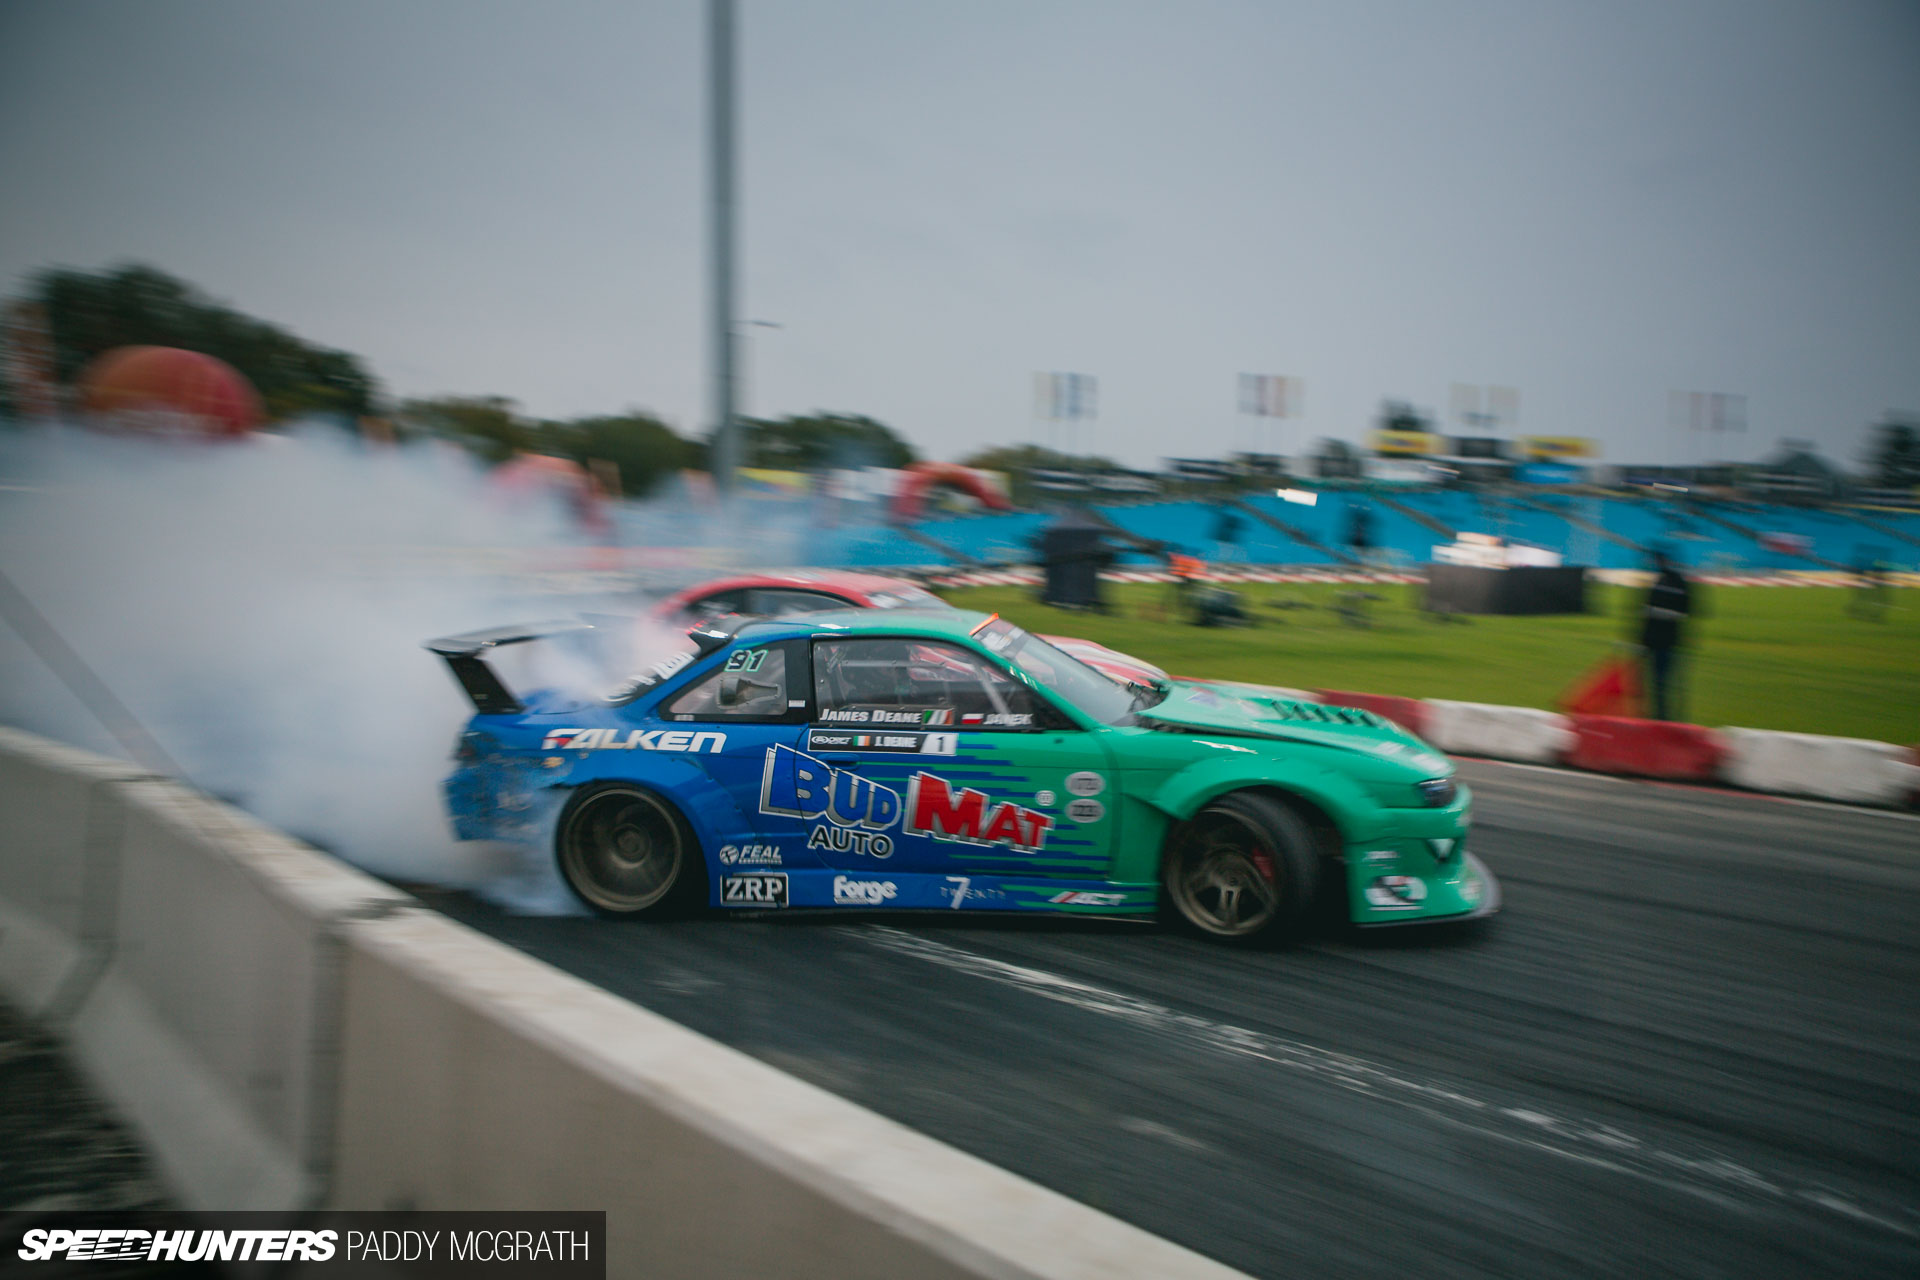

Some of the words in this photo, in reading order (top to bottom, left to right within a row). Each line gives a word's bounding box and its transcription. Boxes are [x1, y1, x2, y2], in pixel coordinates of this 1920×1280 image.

[725, 649, 768, 672] 91
[819, 708, 869, 723] JAMES
[872, 709, 922, 724] DEANE
[541, 728, 727, 753] FALKEN
[936, 735, 946, 753] 1
[759, 743, 902, 831] BUD
[902, 770, 1056, 855] MAT
[738, 844, 782, 859] FEAL
[807, 824, 894, 859] AUTO
[725, 876, 784, 902] ZRP
[945, 875, 971, 910] 7
